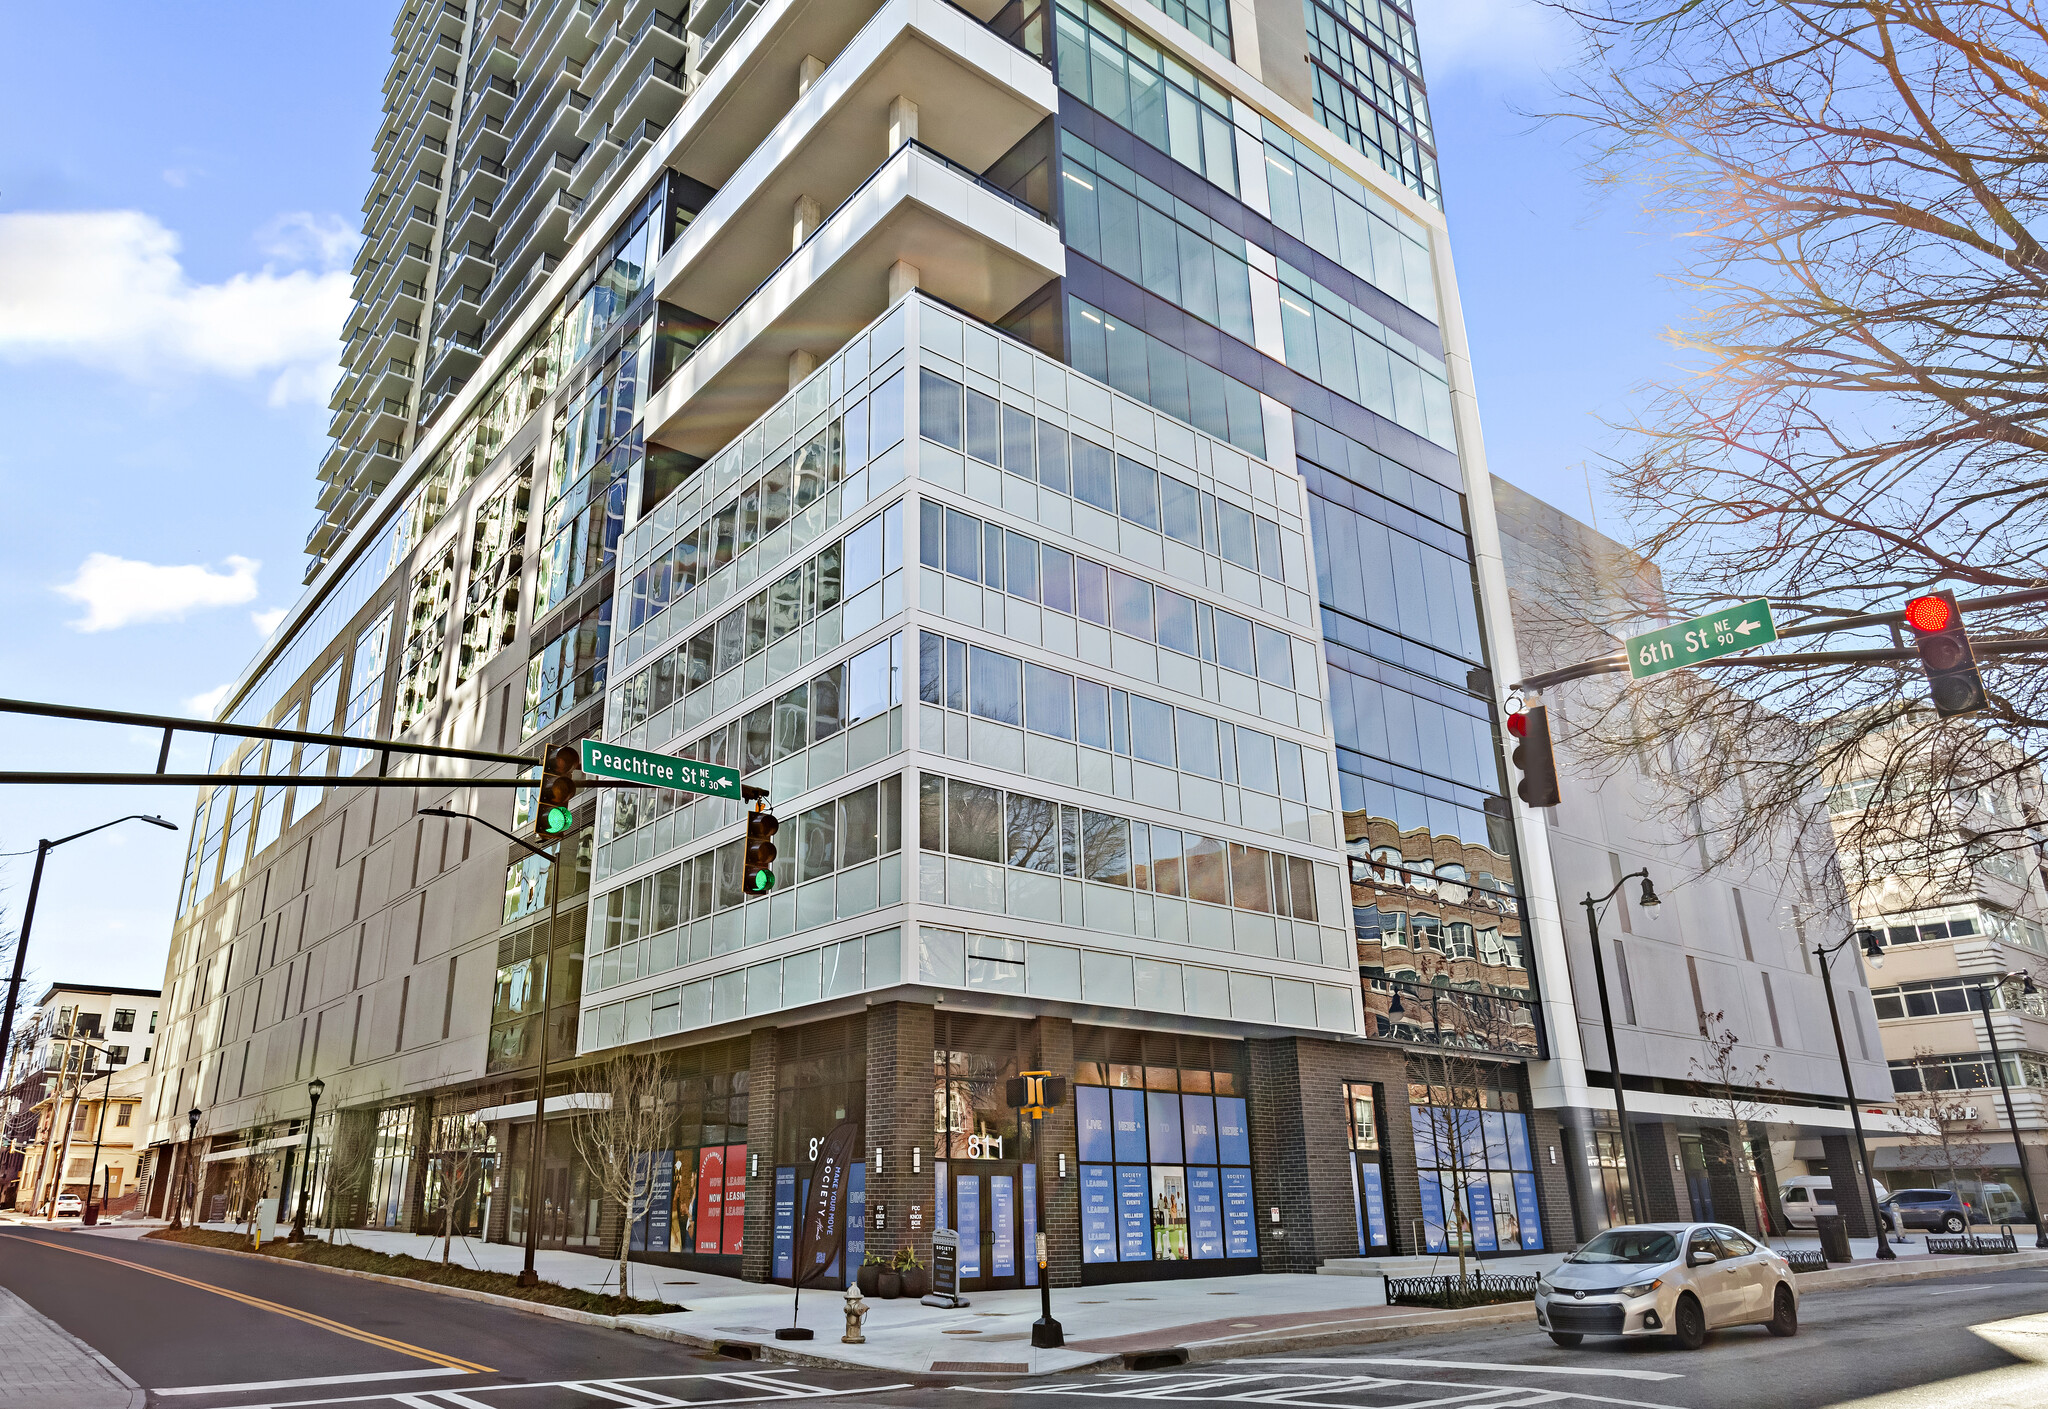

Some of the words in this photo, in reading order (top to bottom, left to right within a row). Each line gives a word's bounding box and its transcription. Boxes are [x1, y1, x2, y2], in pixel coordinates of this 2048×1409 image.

[1714, 619, 1731, 634] NE
[1717, 633, 1734, 646] 90
[1640, 640, 1674, 666] 6th
[1685, 628, 1709, 653] St
[591, 749, 674, 780] Peachtree
[681, 766, 697, 784] St
[700, 768, 710, 779] NE
[1086, 1119, 1102, 1130] LIVE
[1118, 1121, 1136, 1132] HERE
[1192, 1124, 1208, 1135] LIVE
[1222, 1126, 1239, 1137] HERE
[967, 1134, 1003, 1160] 811
[700, 1151, 724, 1178] ENTERTAINMENT
[709, 1177, 722, 1187] NOW
[726, 1176, 746, 1187] LEASIN
[832, 1166, 841, 1189] MAKE
[817, 1157, 834, 1217] SOCIETY
[709, 1193, 721, 1203] NOW
[726, 1192, 746, 1201] LEASIN
[829, 1190, 837, 1212] YOUR
[708, 1207, 720, 1217] NOW
[725, 1206, 745, 1216] LEASIN
[826, 1213, 835, 1236] MOVE
[701, 1242, 717, 1250] DINING
